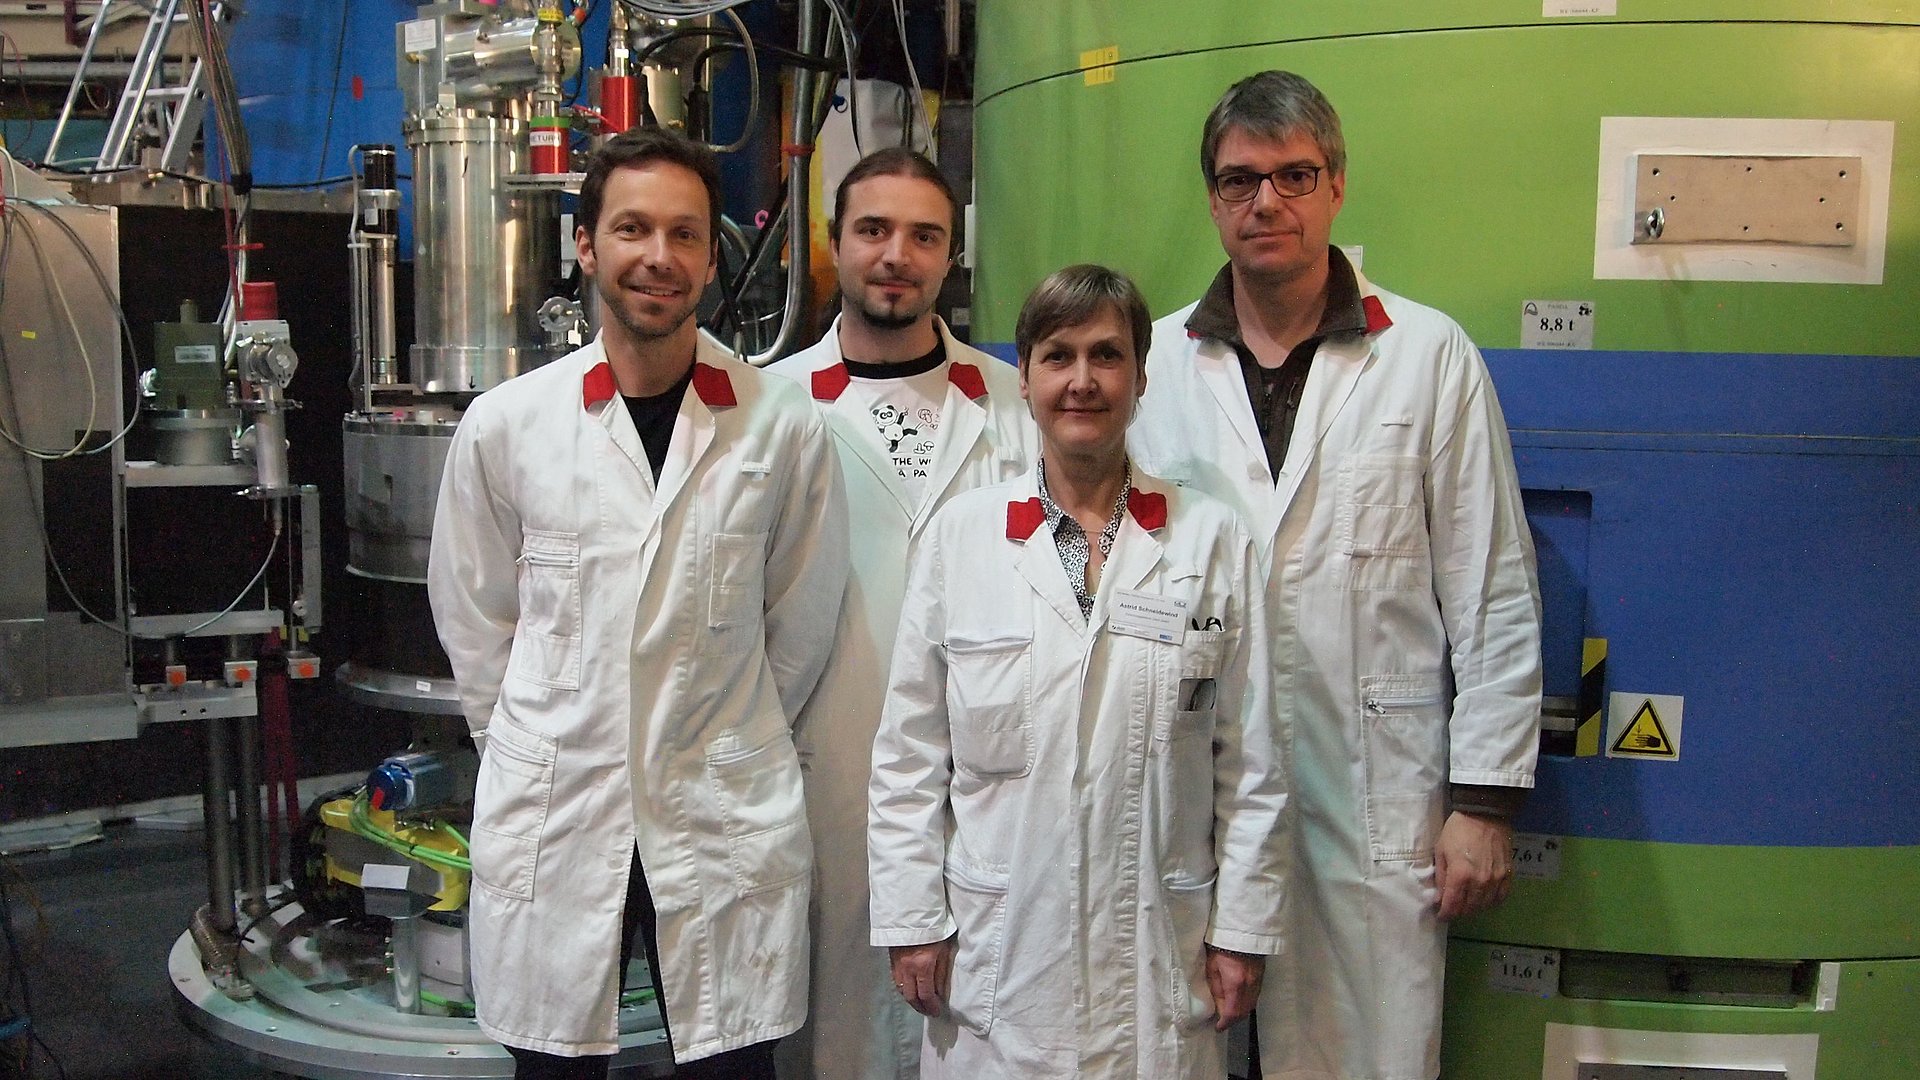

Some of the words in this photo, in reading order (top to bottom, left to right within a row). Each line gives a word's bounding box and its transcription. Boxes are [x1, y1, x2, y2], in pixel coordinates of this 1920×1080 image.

[531, 133, 560, 143] ETURN
[1540, 317, 1563, 333] 8,8
[1568, 319, 1575, 332] t
[892, 457, 913, 466] THE
[1119, 602, 1138, 611] Astrid
[1138, 605, 1179, 618] Schneidewind
[1503, 963, 1532, 979] 11,6
